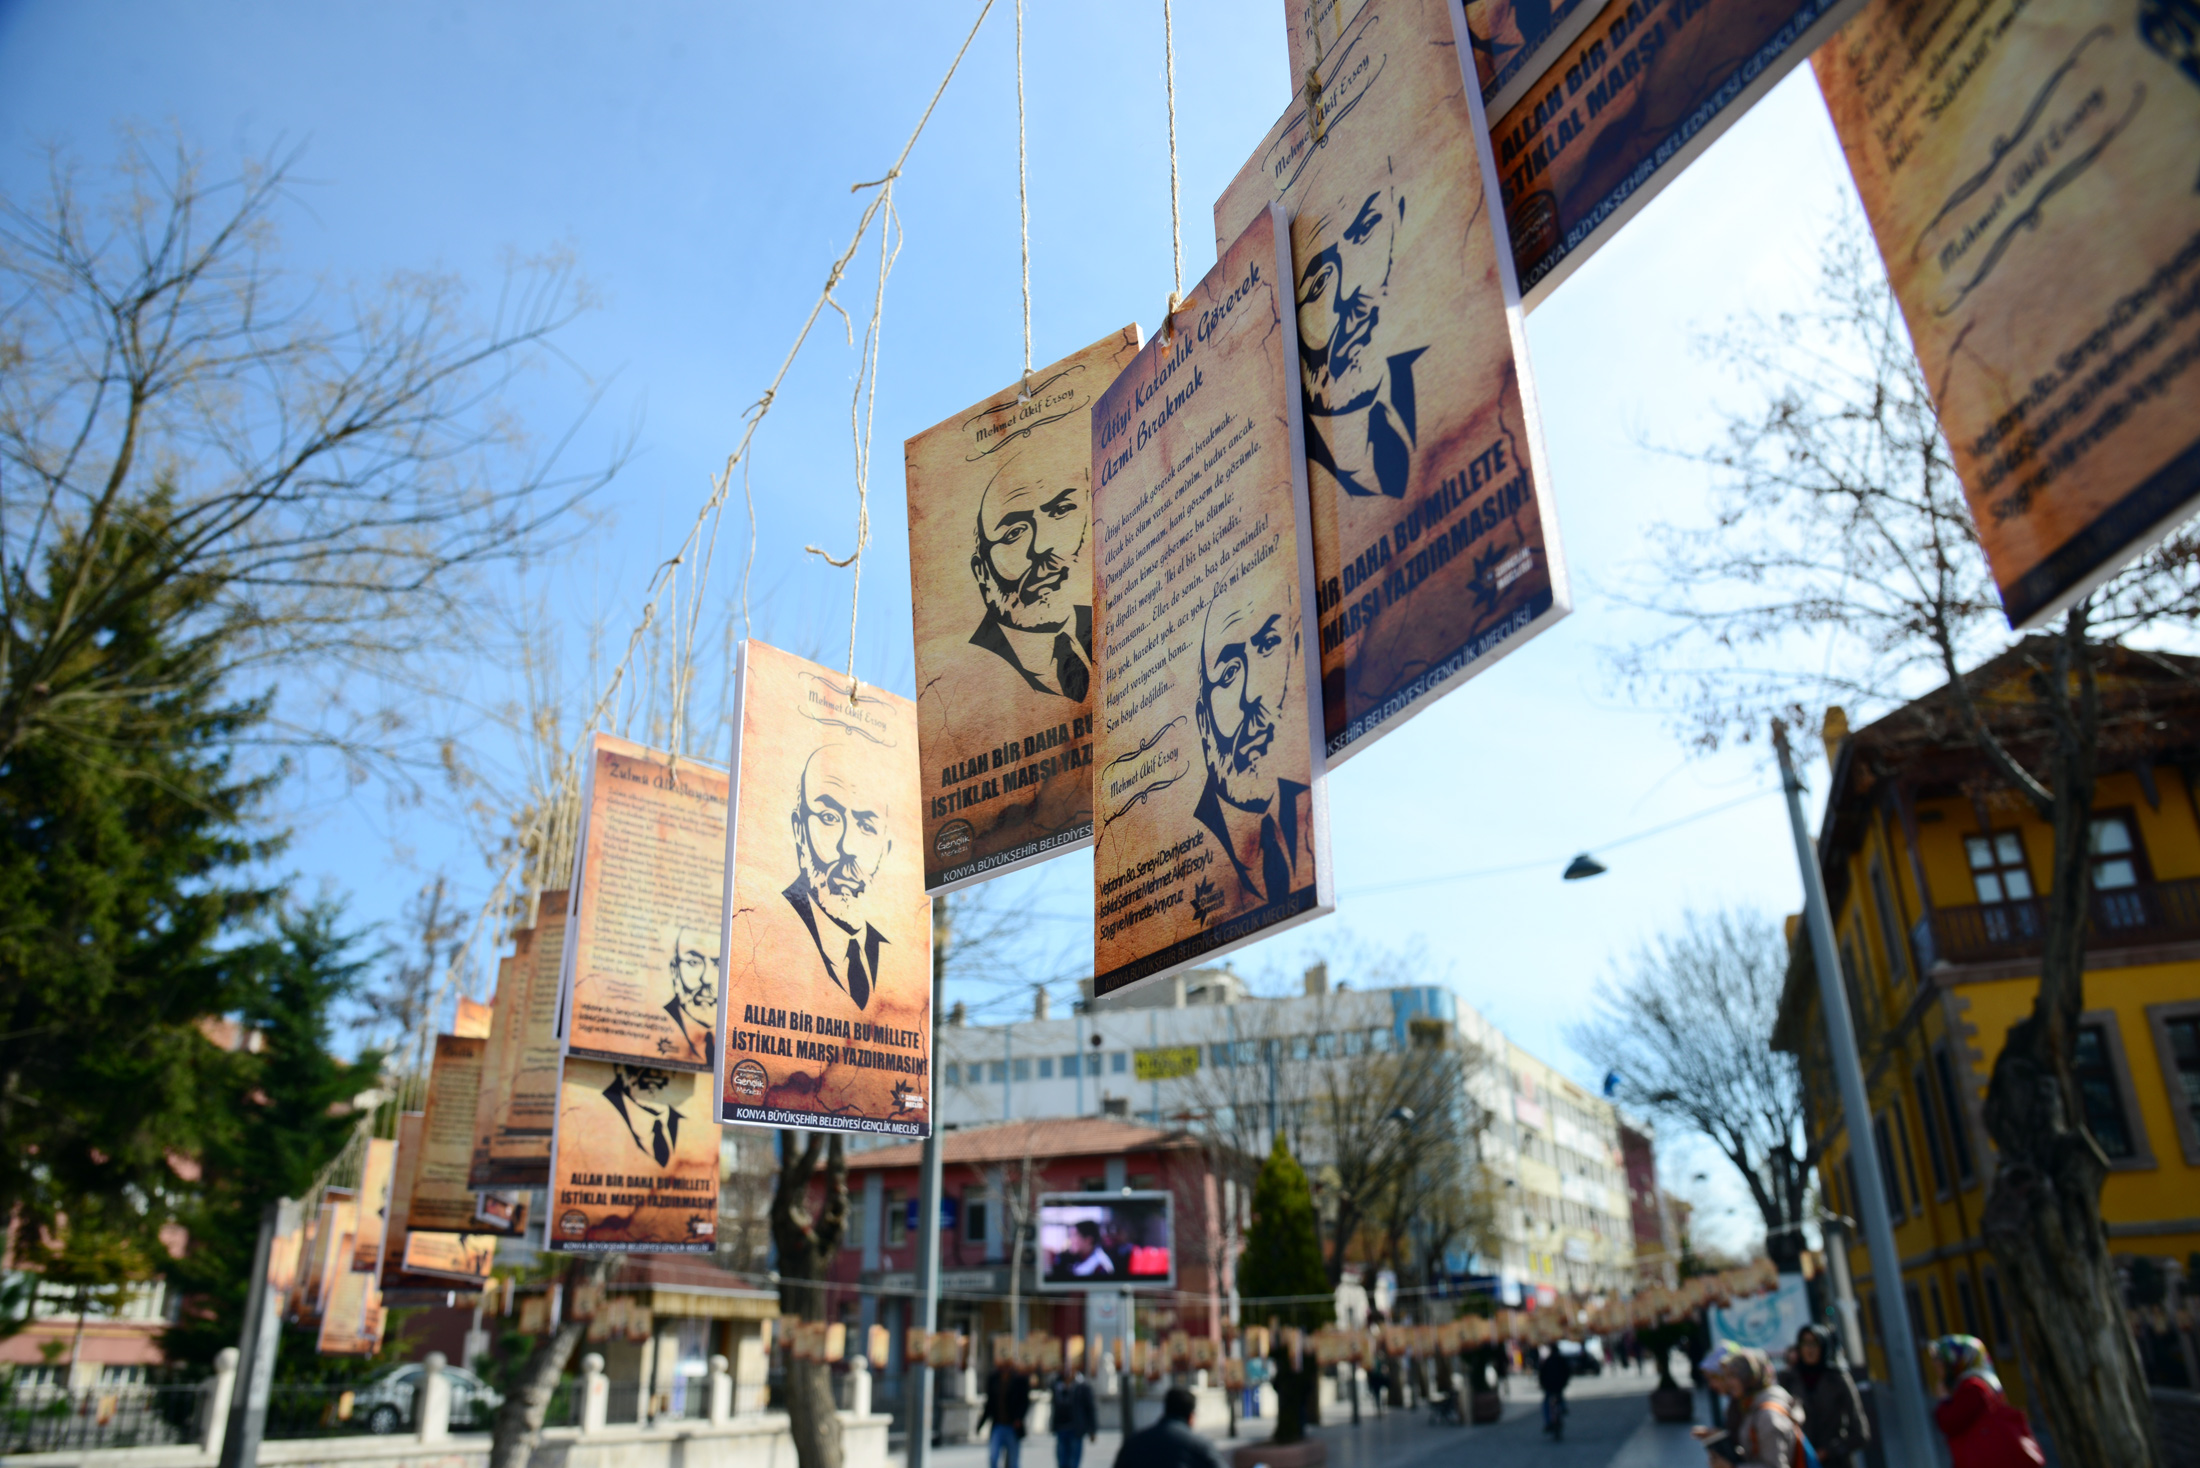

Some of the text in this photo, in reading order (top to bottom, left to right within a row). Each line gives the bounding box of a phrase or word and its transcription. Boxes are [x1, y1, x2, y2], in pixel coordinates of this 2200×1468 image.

[1275, 54, 1370, 179] Mehme Akif Ersoy
[1500, 107, 1586, 208] STİKLAL
[1585, 20, 1666, 121] MARŞI
[1501, 83, 1564, 168] ALLAH
[1565, 38, 1608, 97] BİR
[1522, 243, 1566, 292] KONYA
[1134, 333, 1195, 410] Karanlık
[1197, 260, 1261, 343] Görerek
[976, 389, 1074, 442] Mehmet Akif Ersoy
[1101, 365, 1204, 487] Azmi Bırakmak
[1104, 540, 1124, 566] Alçak
[1124, 534, 1134, 547] bir
[1135, 517, 1152, 537] ölüm
[1203, 446, 1227, 473] budur
[1228, 417, 1256, 450] ancak.
[1121, 492, 1149, 527] karanlık
[1149, 465, 1176, 500] görerek
[1177, 452, 1194, 473] azmi
[1195, 412, 1238, 455] bırakmak...
[1169, 510, 1186, 531] hani
[1186, 485, 1213, 515] görsem
[1214, 473, 1224, 489] de
[1225, 441, 1262, 479] gözümle.
[1124, 578, 1139, 596] olan
[1140, 559, 1159, 582] kimse
[1160, 528, 1193, 564] gebermez
[1194, 519, 1205, 533] bu
[1206, 492, 1234, 523] ölümle:
[1342, 534, 1393, 597] DAHA
[1394, 507, 1422, 554] BU
[1425, 439, 1506, 531] MİLLETE
[1105, 624, 1115, 637] Ey
[1115, 604, 1137, 628] dipdiri
[1177, 557, 1185, 575] el
[1185, 553, 1196, 567] bir
[1197, 540, 1211, 557] baş
[1106, 622, 1151, 660] Davransana...
[1152, 602, 1170, 622] Eller
[1170, 591, 1180, 607] de
[1205, 561, 1218, 578] baş
[1219, 550, 1231, 566] da
[1232, 513, 1269, 556] senindir!
[1323, 468, 1530, 656] MARŞI YAZDIRMASIN!
[1106, 668, 1117, 685] His
[1133, 633, 1159, 663] hareket
[1177, 613, 1189, 628] acı
[1229, 573, 1239, 586] mi
[1241, 533, 1280, 577] kesildin?
[1106, 641, 1194, 709] Hayret veriyorsun bana...
[1365, 675, 1426, 732] BELEDİYESİ
[1425, 644, 1478, 690] GENÇLİK
[1478, 603, 1531, 653] MECLİSİ
[809, 690, 887, 732] Mehmet Akif Ersoy
[1106, 682, 1175, 735] Sen böyle değildin...
[610, 762, 729, 806] Zulmü Alkışlayama
[931, 742, 1093, 819] İSTİKLAL MARŞI YAZ
[942, 753, 989, 788] ALLAH
[992, 742, 1020, 769] BİR
[1024, 723, 1070, 757] DAHA
[1110, 747, 1179, 798] Mehmet Akif Ersoy
[937, 836, 970, 851] Gençlik
[943, 822, 1093, 883] KONYA BÜYÜKŞEHİR BELEDİYESİ
[1159, 829, 1204, 866] Devriyesinde
[1141, 870, 1173, 897] Mehmet
[1172, 859, 1187, 881] Akif
[1152, 889, 1184, 915] Anıyoruz
[1105, 967, 1128, 991] KONYA
[732, 1027, 928, 1076] İSTİKLAL MARŞI YAZDIRMASIN!
[744, 1004, 920, 1049] ALLAH BİR DAHA BU MİLLETE
[736, 1107, 919, 1135] KONYA BÜYÜKŞEHİR BELEDİYESİ GENÇLİK MECLİSİ
[561, 1191, 607, 1206] İSTİKLAL
[610, 1194, 645, 1208] MARŞI
[571, 1173, 710, 1191] ALLAH BİR DAHA BU MİLLETE
